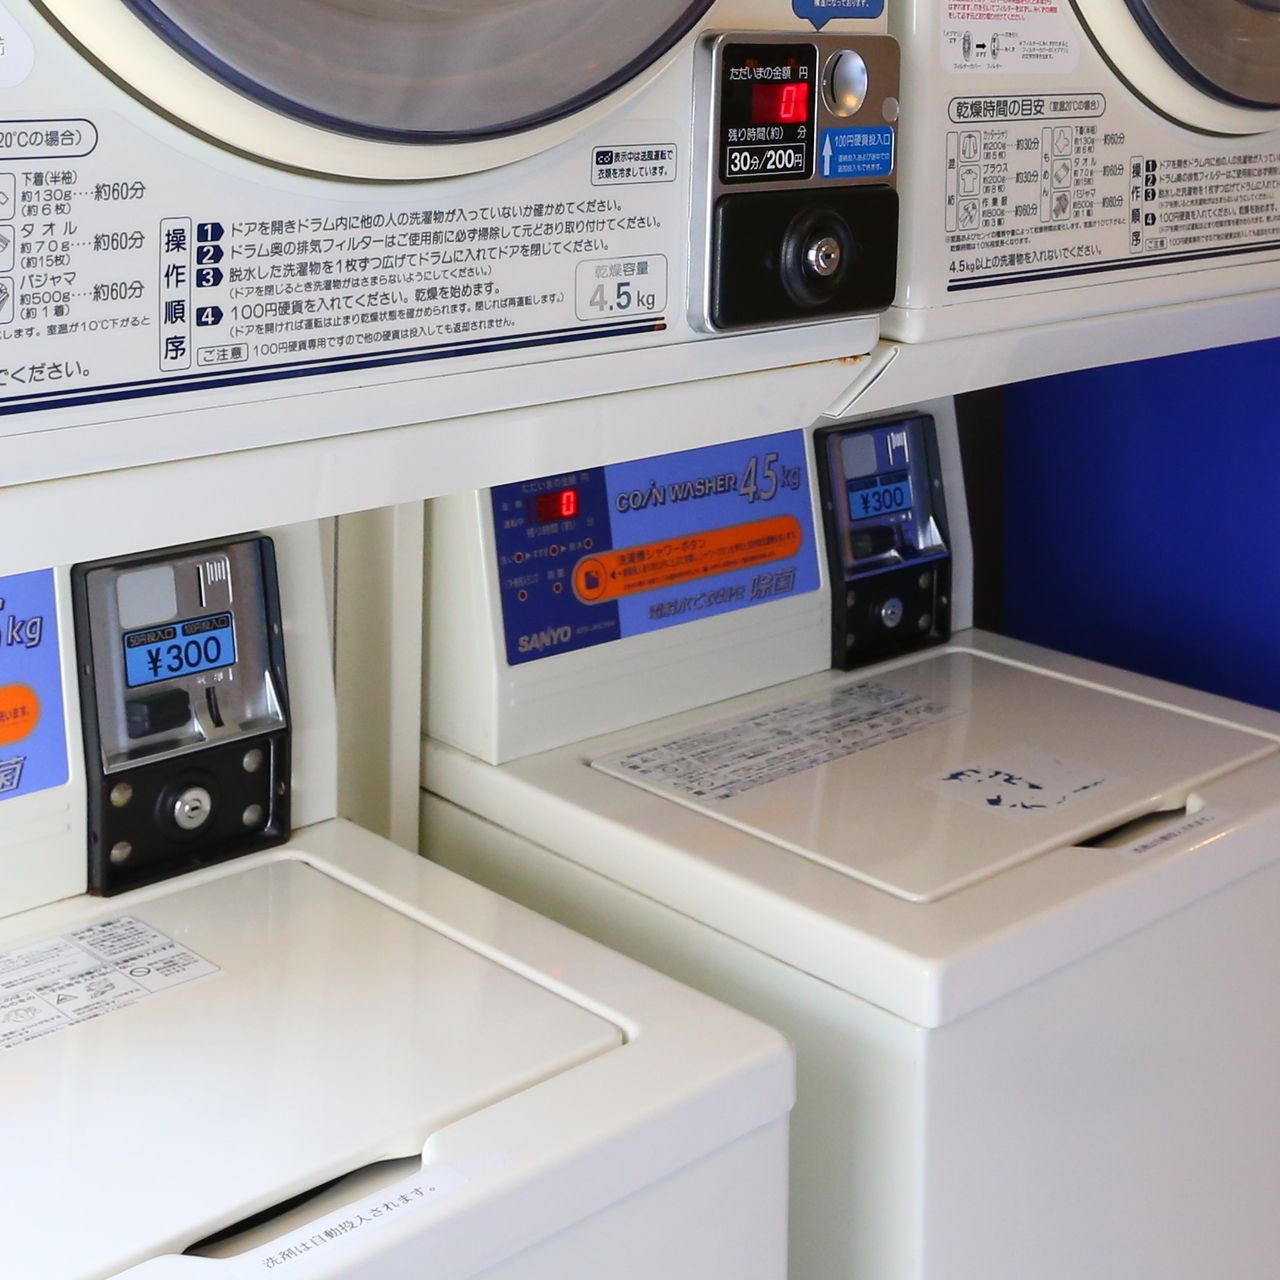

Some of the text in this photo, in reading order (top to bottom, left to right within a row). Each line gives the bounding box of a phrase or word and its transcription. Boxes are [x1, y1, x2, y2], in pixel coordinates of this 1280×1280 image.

[730, 66, 808, 80] ただいまの金額 円
[956, 99, 1045, 119] 乾燥時間の目安
[797, 126, 806, 139] 分
[595, 261, 648, 278] 乾燥容量
[20, 272, 76, 289] パジャマ
[203, 346, 242, 362] ご注意
[671, 473, 737, 502] WASHER
[562, 491, 575, 515] 0
[861, 487, 904, 514] ¥300
[518, 626, 571, 653] SANYO
[147, 636, 221, 677] ¥300
